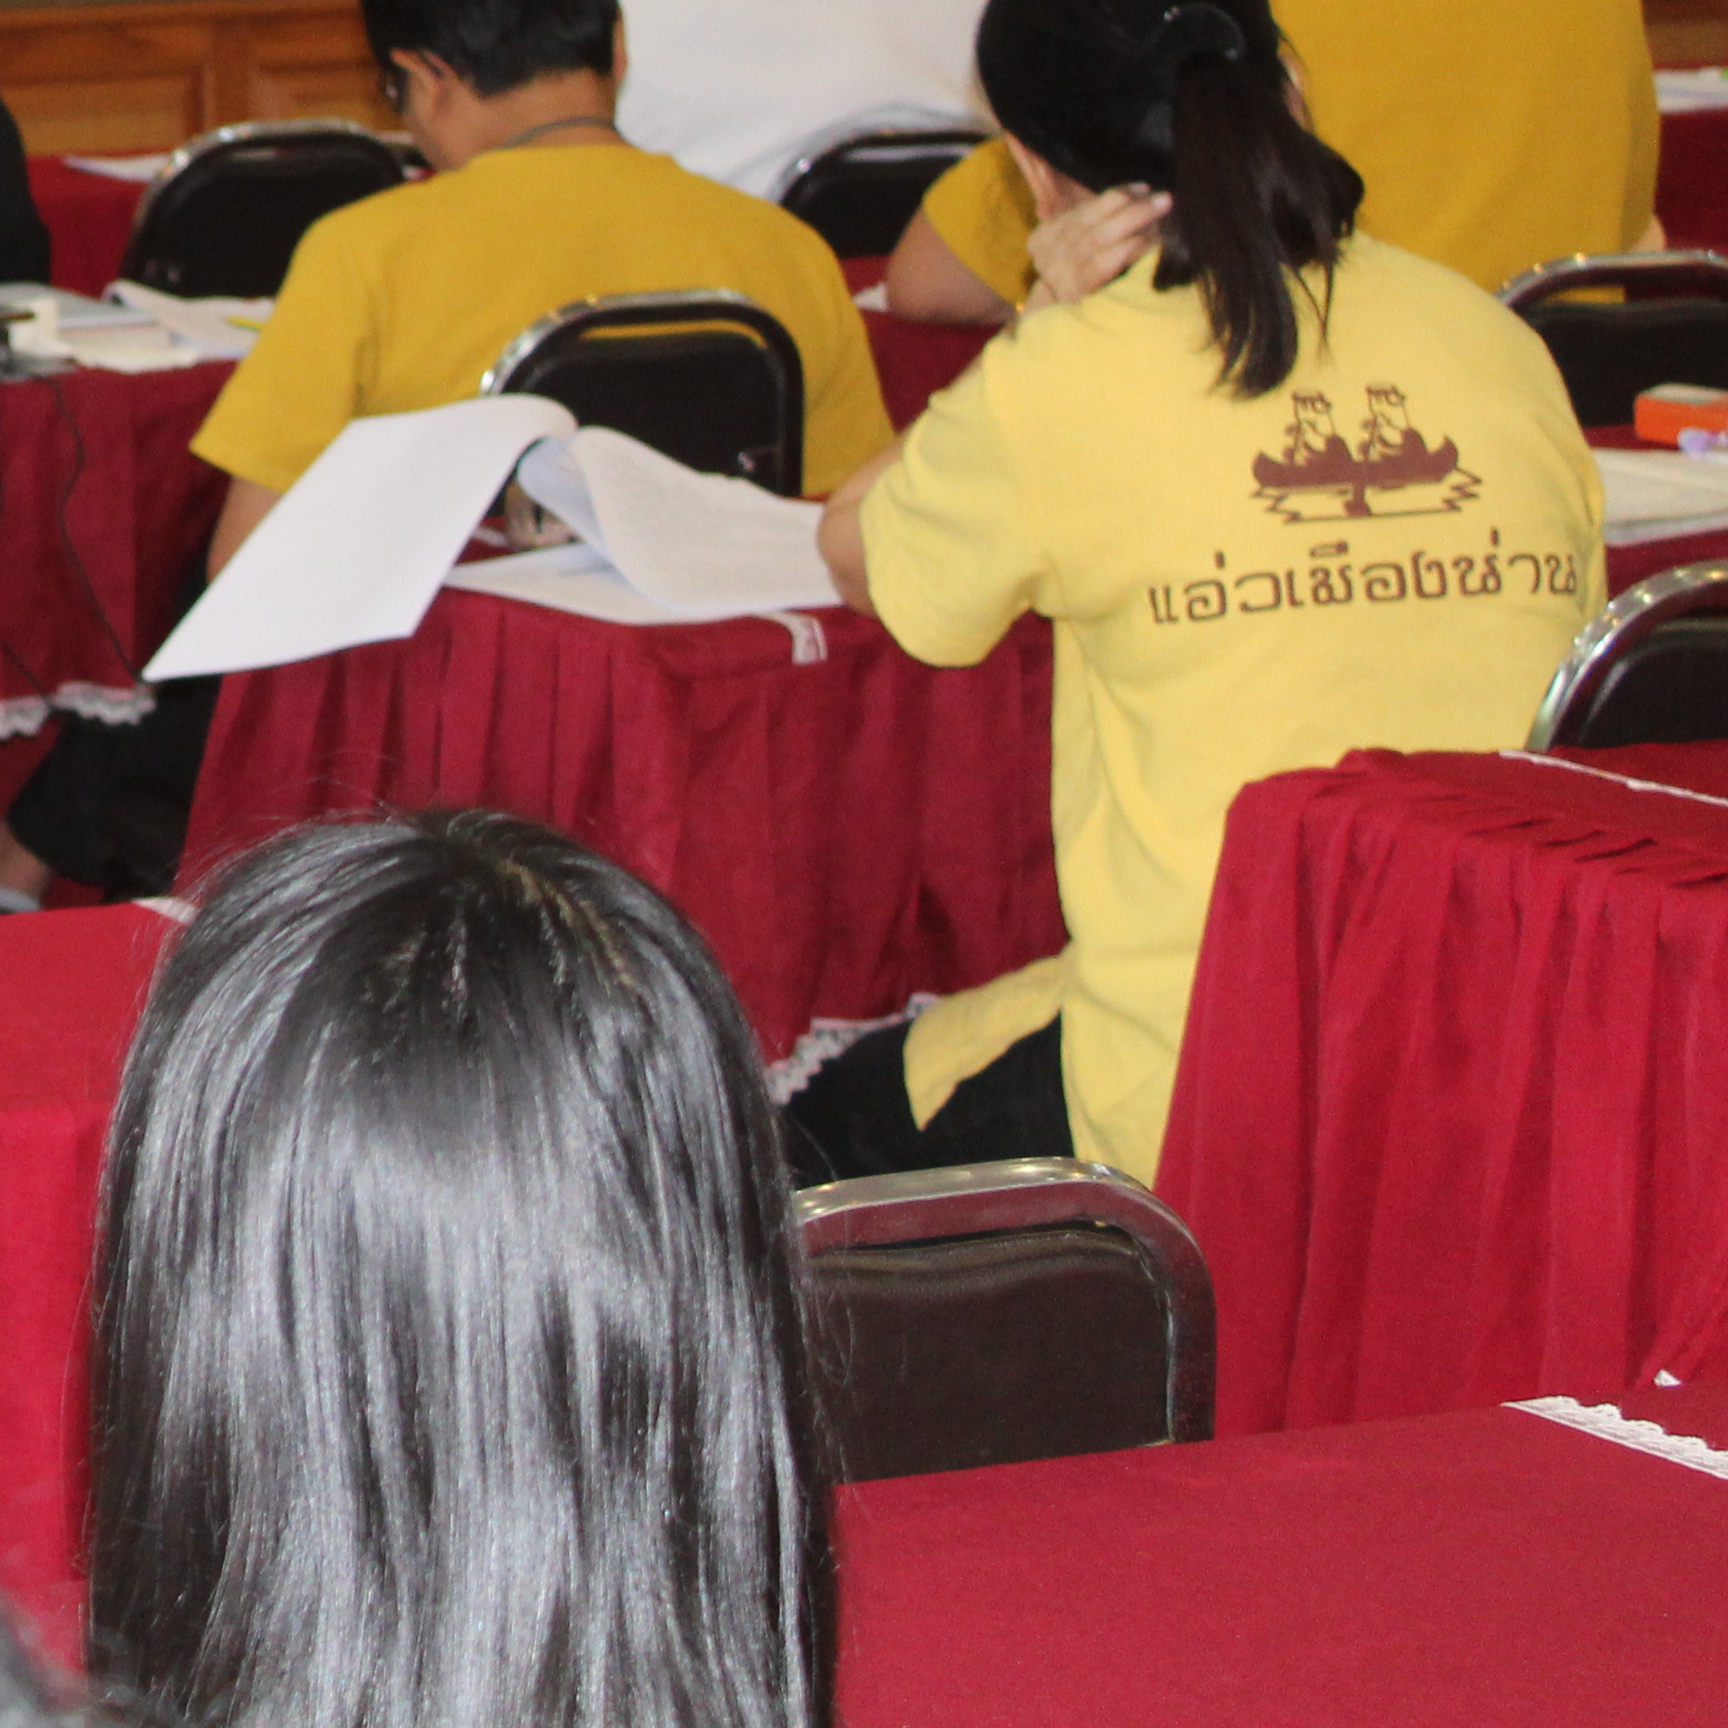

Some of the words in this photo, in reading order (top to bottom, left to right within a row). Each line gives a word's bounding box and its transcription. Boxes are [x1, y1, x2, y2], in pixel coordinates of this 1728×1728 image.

[1148, 528, 1578, 625] แอ่วเมืองน่าน
